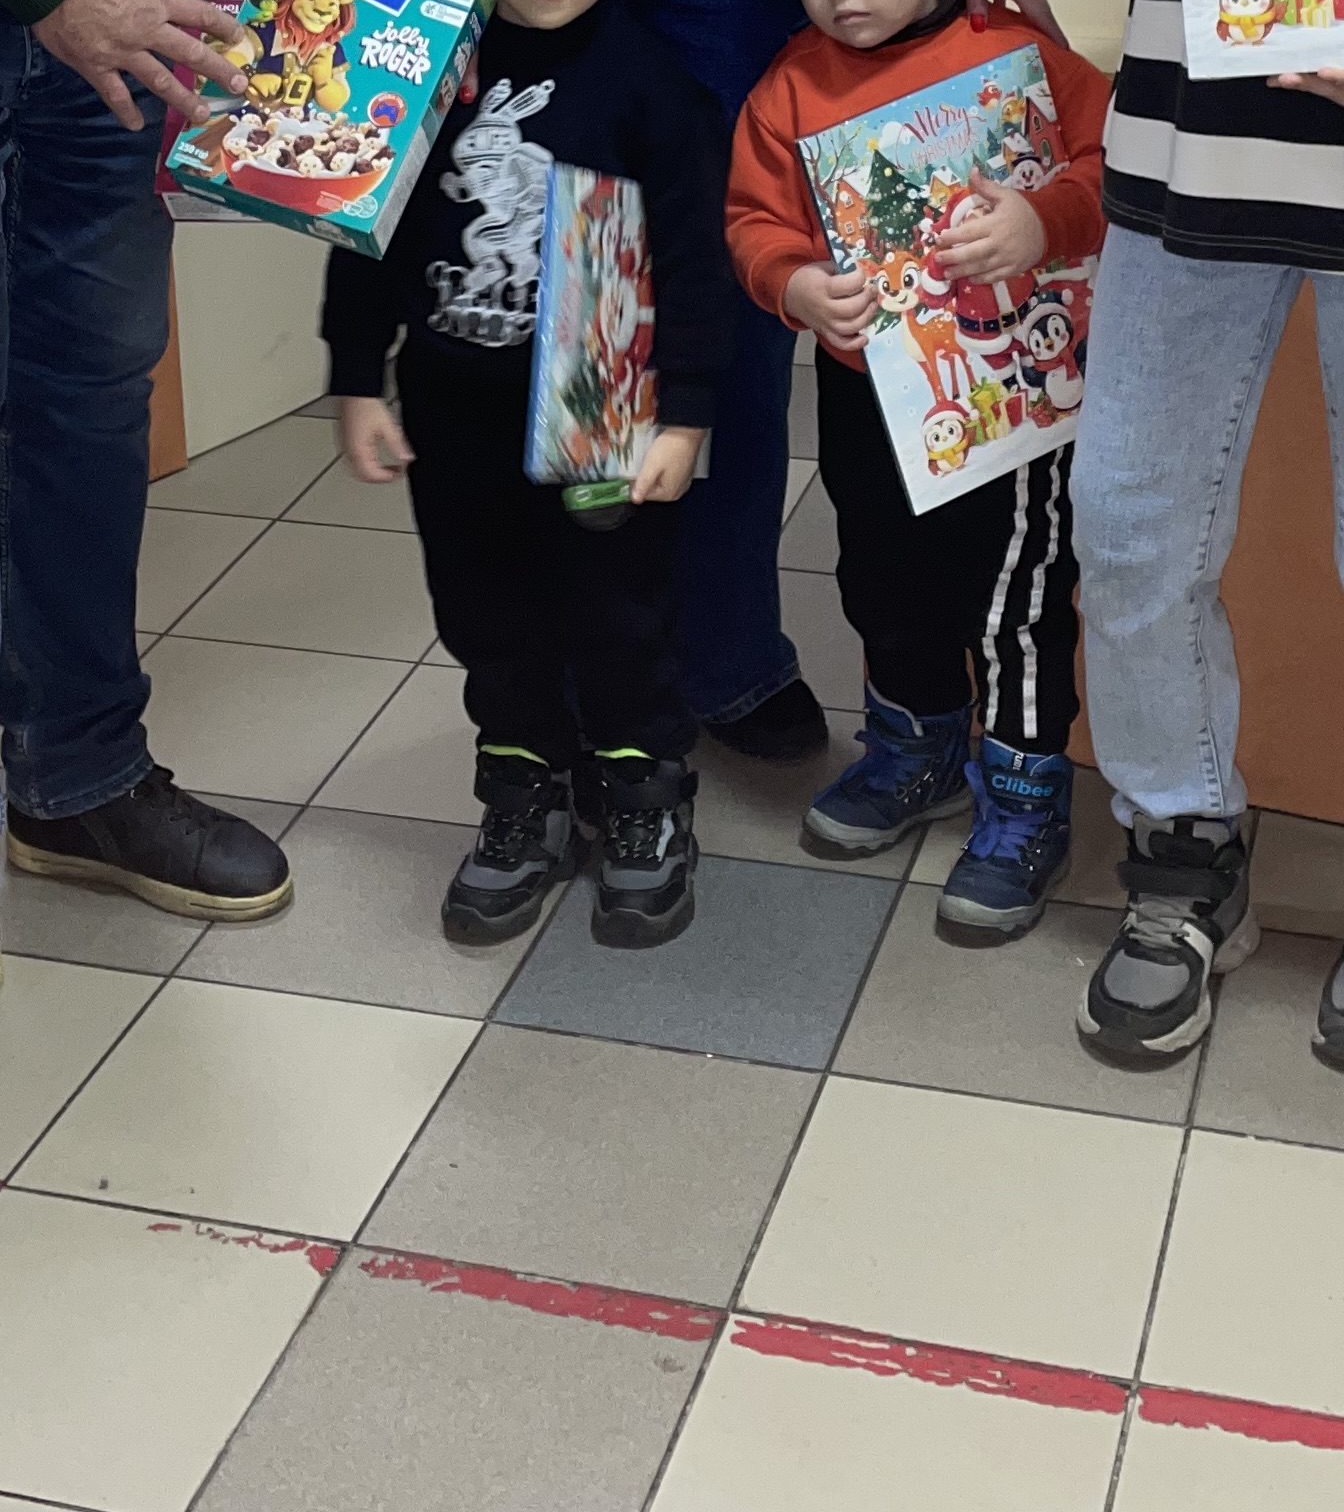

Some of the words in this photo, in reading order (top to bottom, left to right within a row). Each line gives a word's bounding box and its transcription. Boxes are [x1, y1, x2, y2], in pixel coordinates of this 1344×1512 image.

[372, 20, 430, 56] jolly
[360, 36, 432, 85] ROGER
[991, 775, 1054, 798] Clibee
